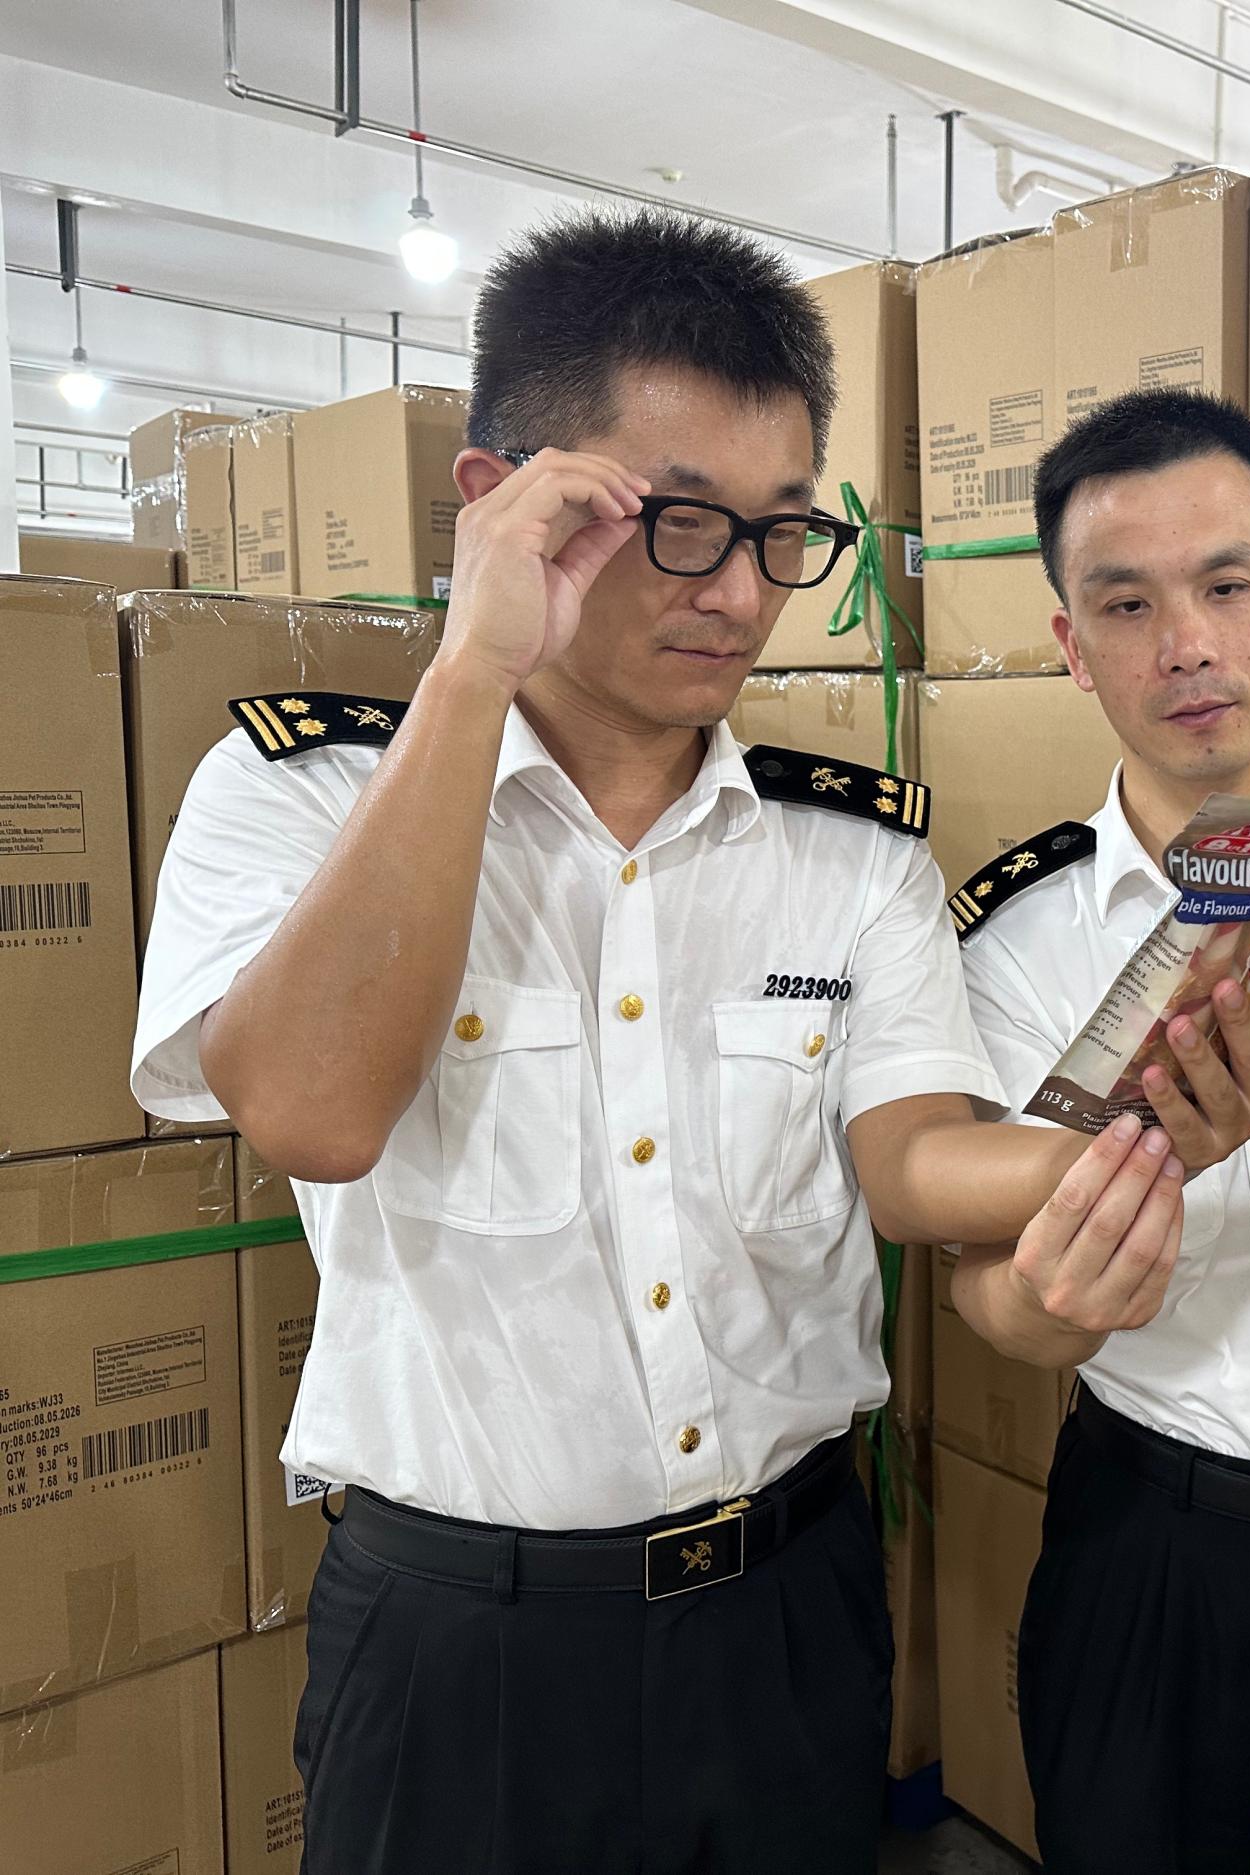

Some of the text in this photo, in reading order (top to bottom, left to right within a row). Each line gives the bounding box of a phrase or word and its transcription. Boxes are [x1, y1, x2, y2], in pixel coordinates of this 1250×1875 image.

[1202, 899, 1250, 916] Flavour
[35, 936, 69, 946] 00322
[77, 935, 83, 944] 6
[763, 973, 852, 1001] 2923900
[1040, 1089, 1075, 1113] 113 g
[278, 1316, 315, 1332] ART:1015
[279, 1350, 296, 1362] Date
[279, 1364, 296, 1377] Date
[8, 1393, 64, 1415] marks:WJ33
[6, 1442, 69, 1465] QTY 96 pcs
[7, 1455, 78, 1481] G.W. 9.38 kg
[8, 1470, 79, 1497] N.W. 7.68 kg
[266, 1826, 284, 1840] Date
[266, 1840, 284, 1853] Date
